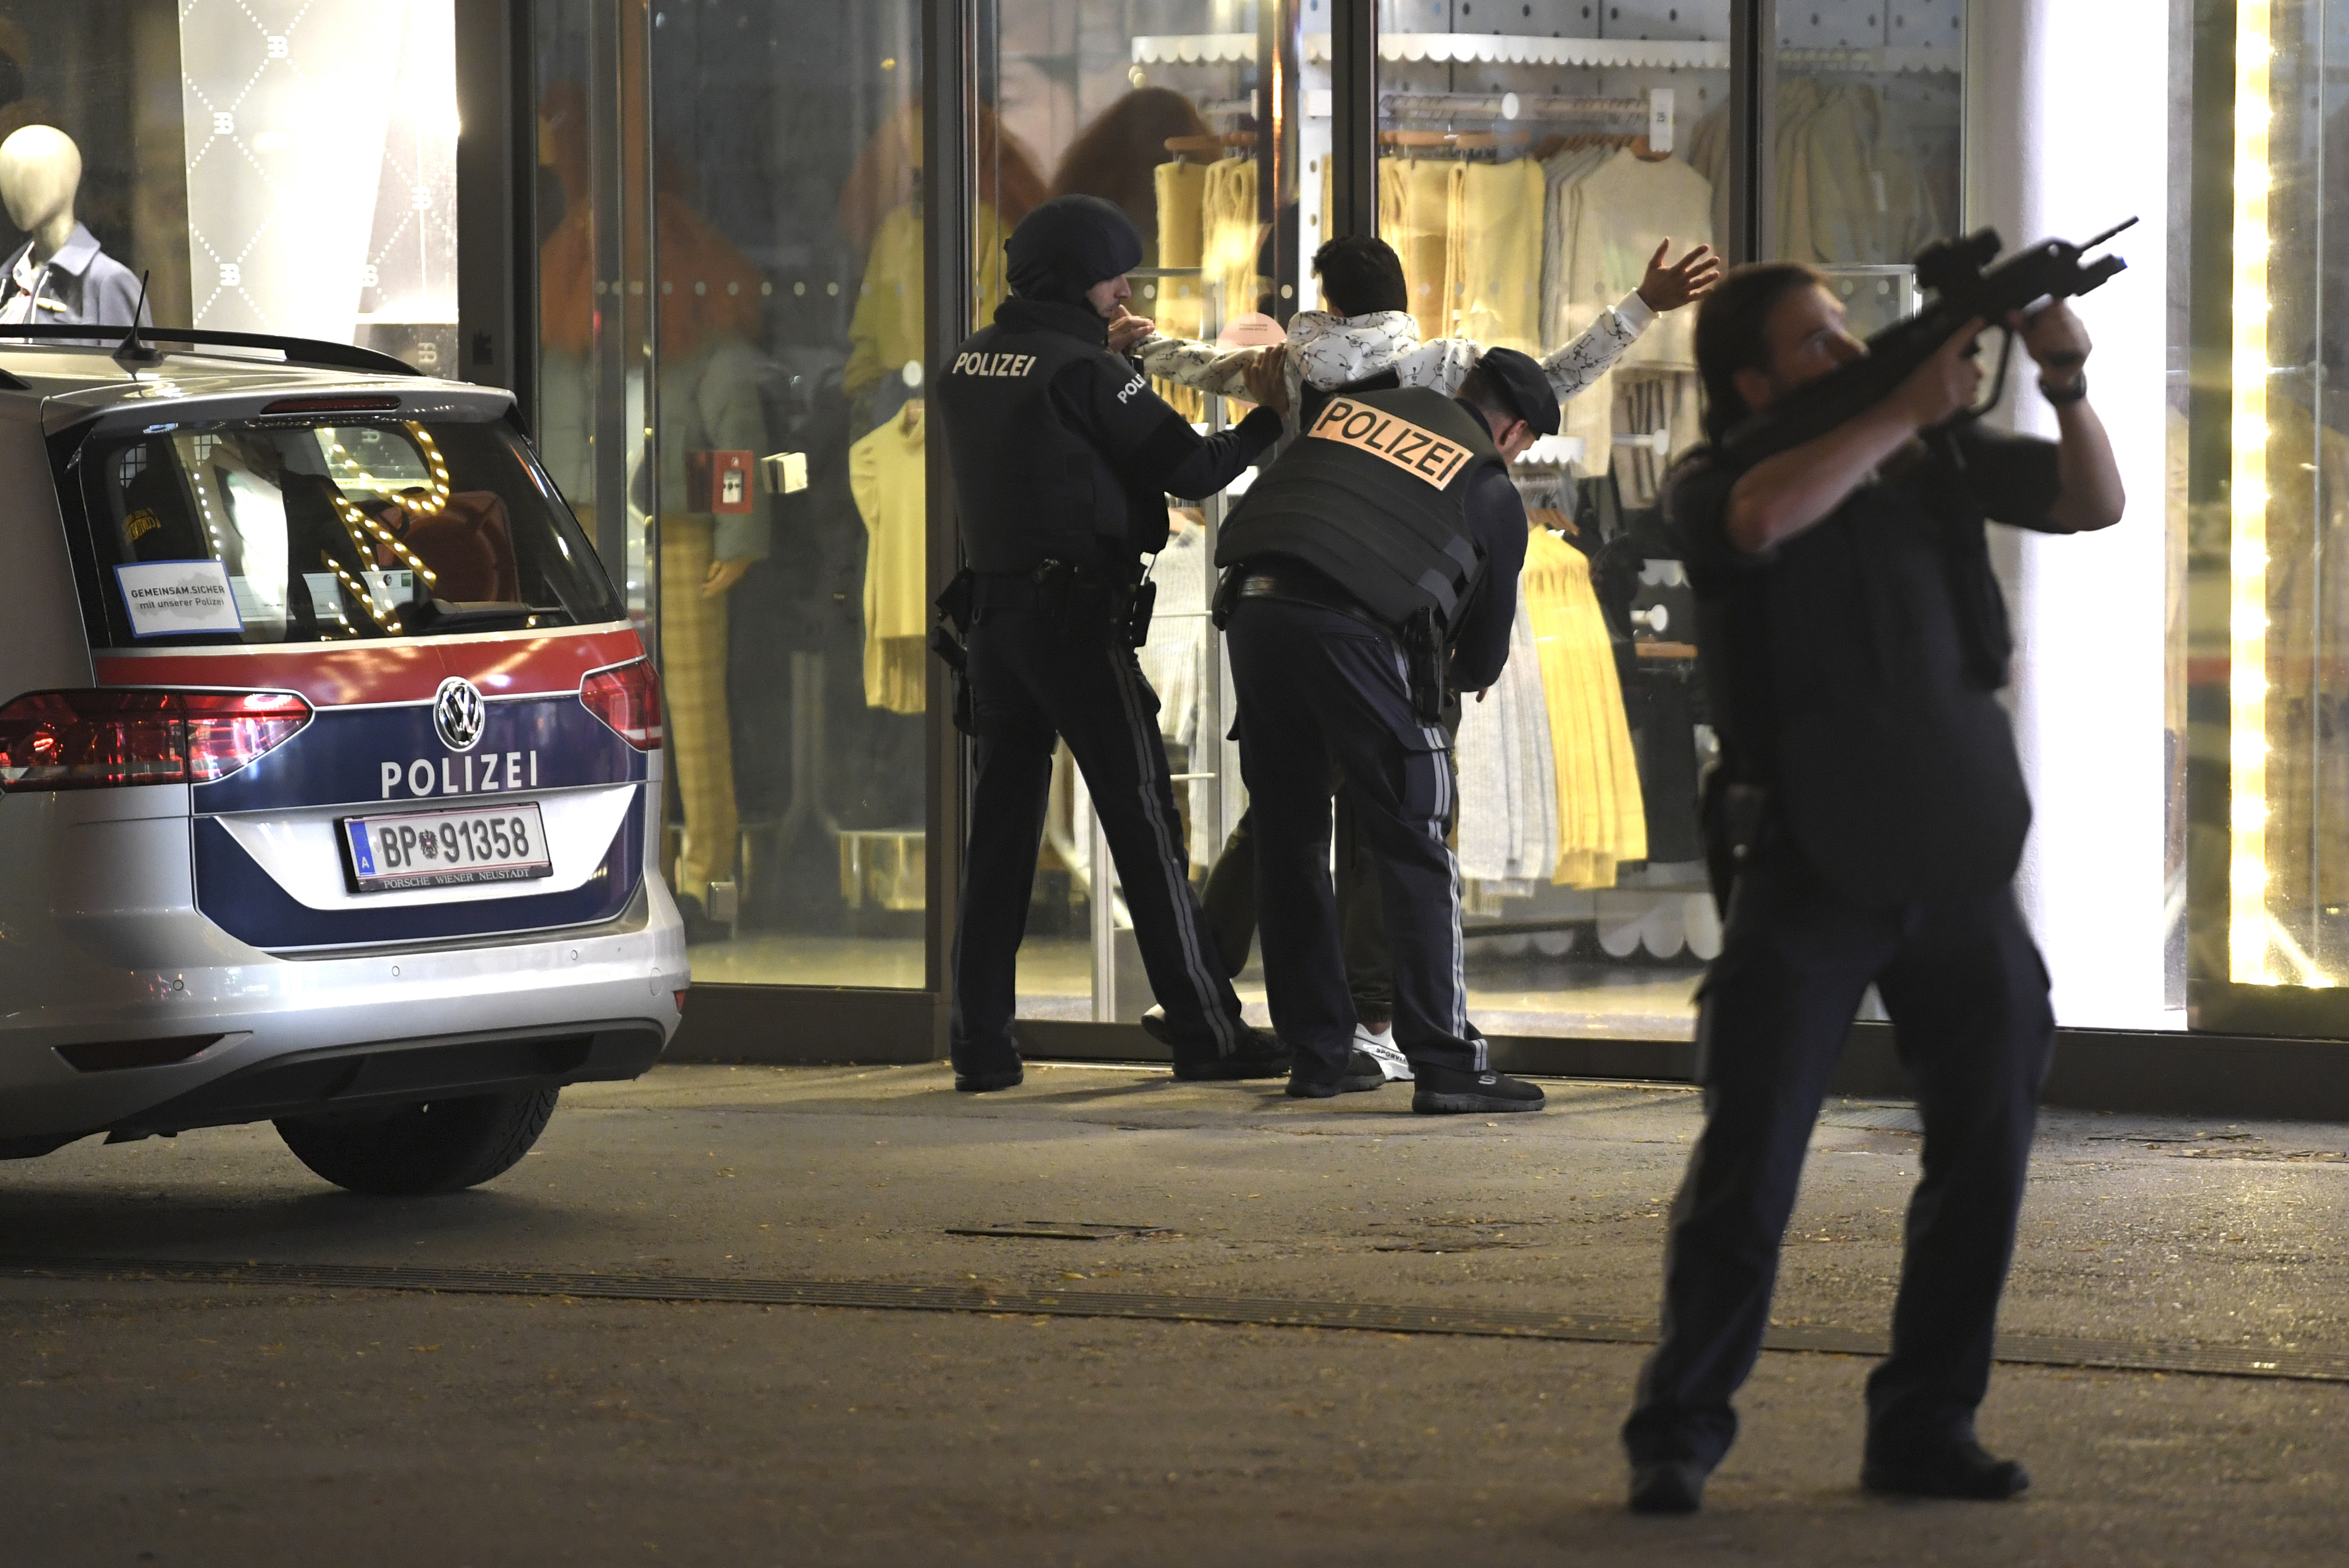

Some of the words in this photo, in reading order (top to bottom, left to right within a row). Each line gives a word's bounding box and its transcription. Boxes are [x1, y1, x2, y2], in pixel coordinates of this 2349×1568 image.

[952, 352, 1036, 376] POLIZEI
[1316, 401, 1464, 482] POLIZEI
[131, 586, 225, 598] GEMEINSAM.SICHER
[140, 600, 155, 610] mit
[157, 600, 193, 608] unserer
[195, 597, 224, 606] Polizei
[381, 751, 537, 799] POLIZEI
[379, 825, 416, 867] BP
[439, 816, 530, 863] 91358
[361, 856, 369, 869] A
[384, 877, 430, 889] PORSCHE
[435, 873, 474, 884] WIENER
[479, 869, 529, 881] NEUSTADT
